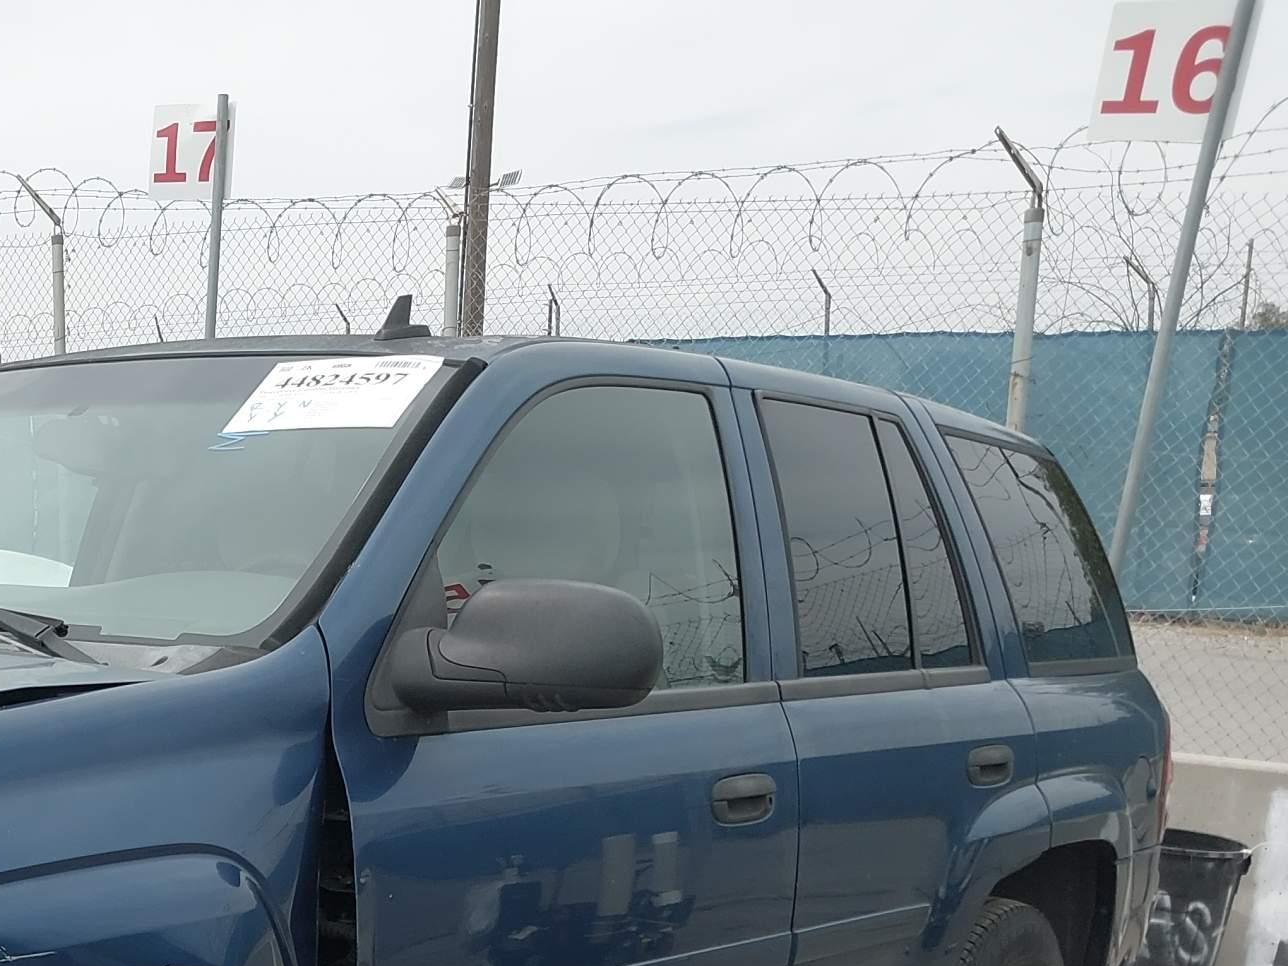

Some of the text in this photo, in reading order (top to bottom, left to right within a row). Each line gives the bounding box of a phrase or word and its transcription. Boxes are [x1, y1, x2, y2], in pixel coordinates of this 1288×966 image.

[1100, 25, 1232, 115] 16
[153, 120, 217, 183] 17
[275, 372, 410, 389] 44824597
